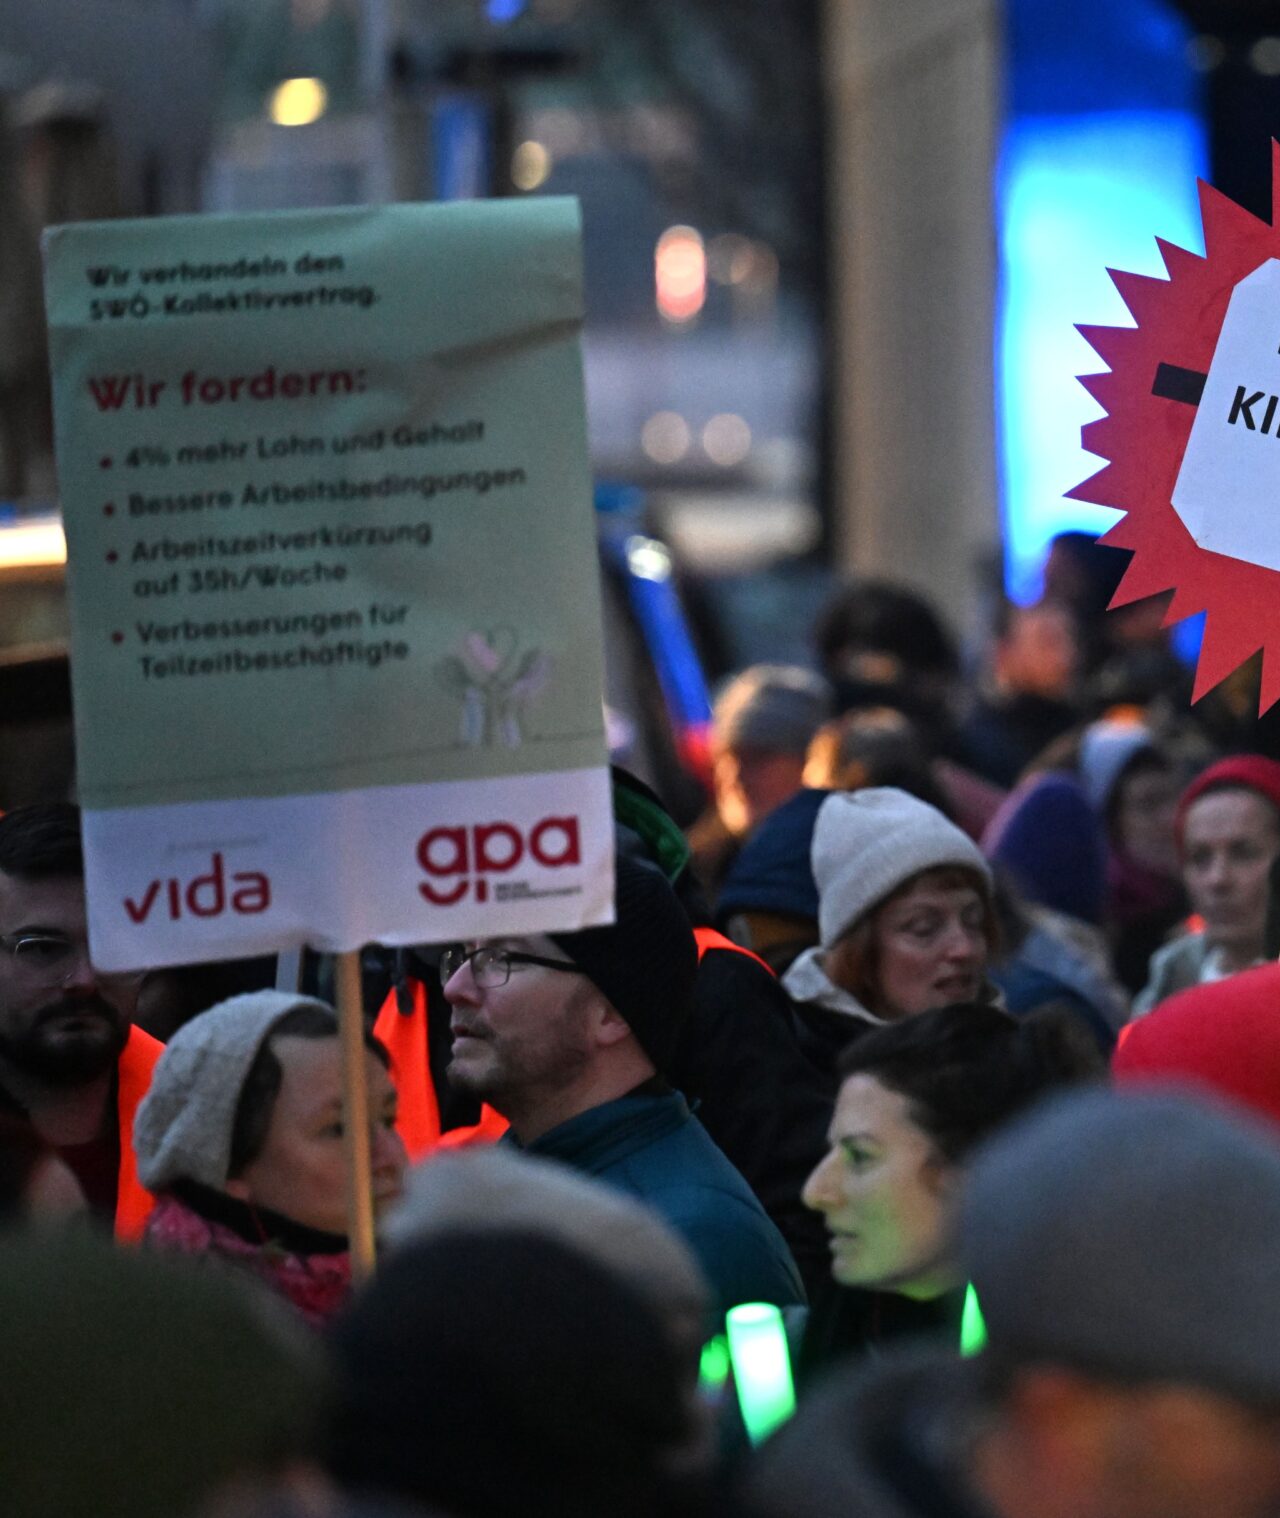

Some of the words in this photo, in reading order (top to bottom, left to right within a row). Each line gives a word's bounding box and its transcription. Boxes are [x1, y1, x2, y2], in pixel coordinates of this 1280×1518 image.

[87, 265, 130, 288] Wir
[140, 257, 287, 285] verhandeln
[294, 253, 344, 276] den
[88, 372, 166, 412] Wir
[180, 366, 367, 406] fordern:
[126, 446, 171, 468] 4%
[177, 439, 248, 465] mehr
[257, 433, 325, 460] Lohn
[332, 429, 384, 453] und
[392, 420, 485, 449] Gehalt
[128, 490, 233, 518] Bessere
[241, 467, 526, 508] Arbeitsbedingungen
[131, 521, 433, 563] Arbeitszeitverkürzung
[133, 572, 179, 598] auf
[188, 561, 348, 594] 35h/Woche
[136, 608, 362, 644] Verbesserungen
[368, 602, 408, 626] für
[140, 640, 410, 680] Teilzeitbeschäftigte
[416, 814, 582, 906] gpa
[123, 851, 272, 924] vida
